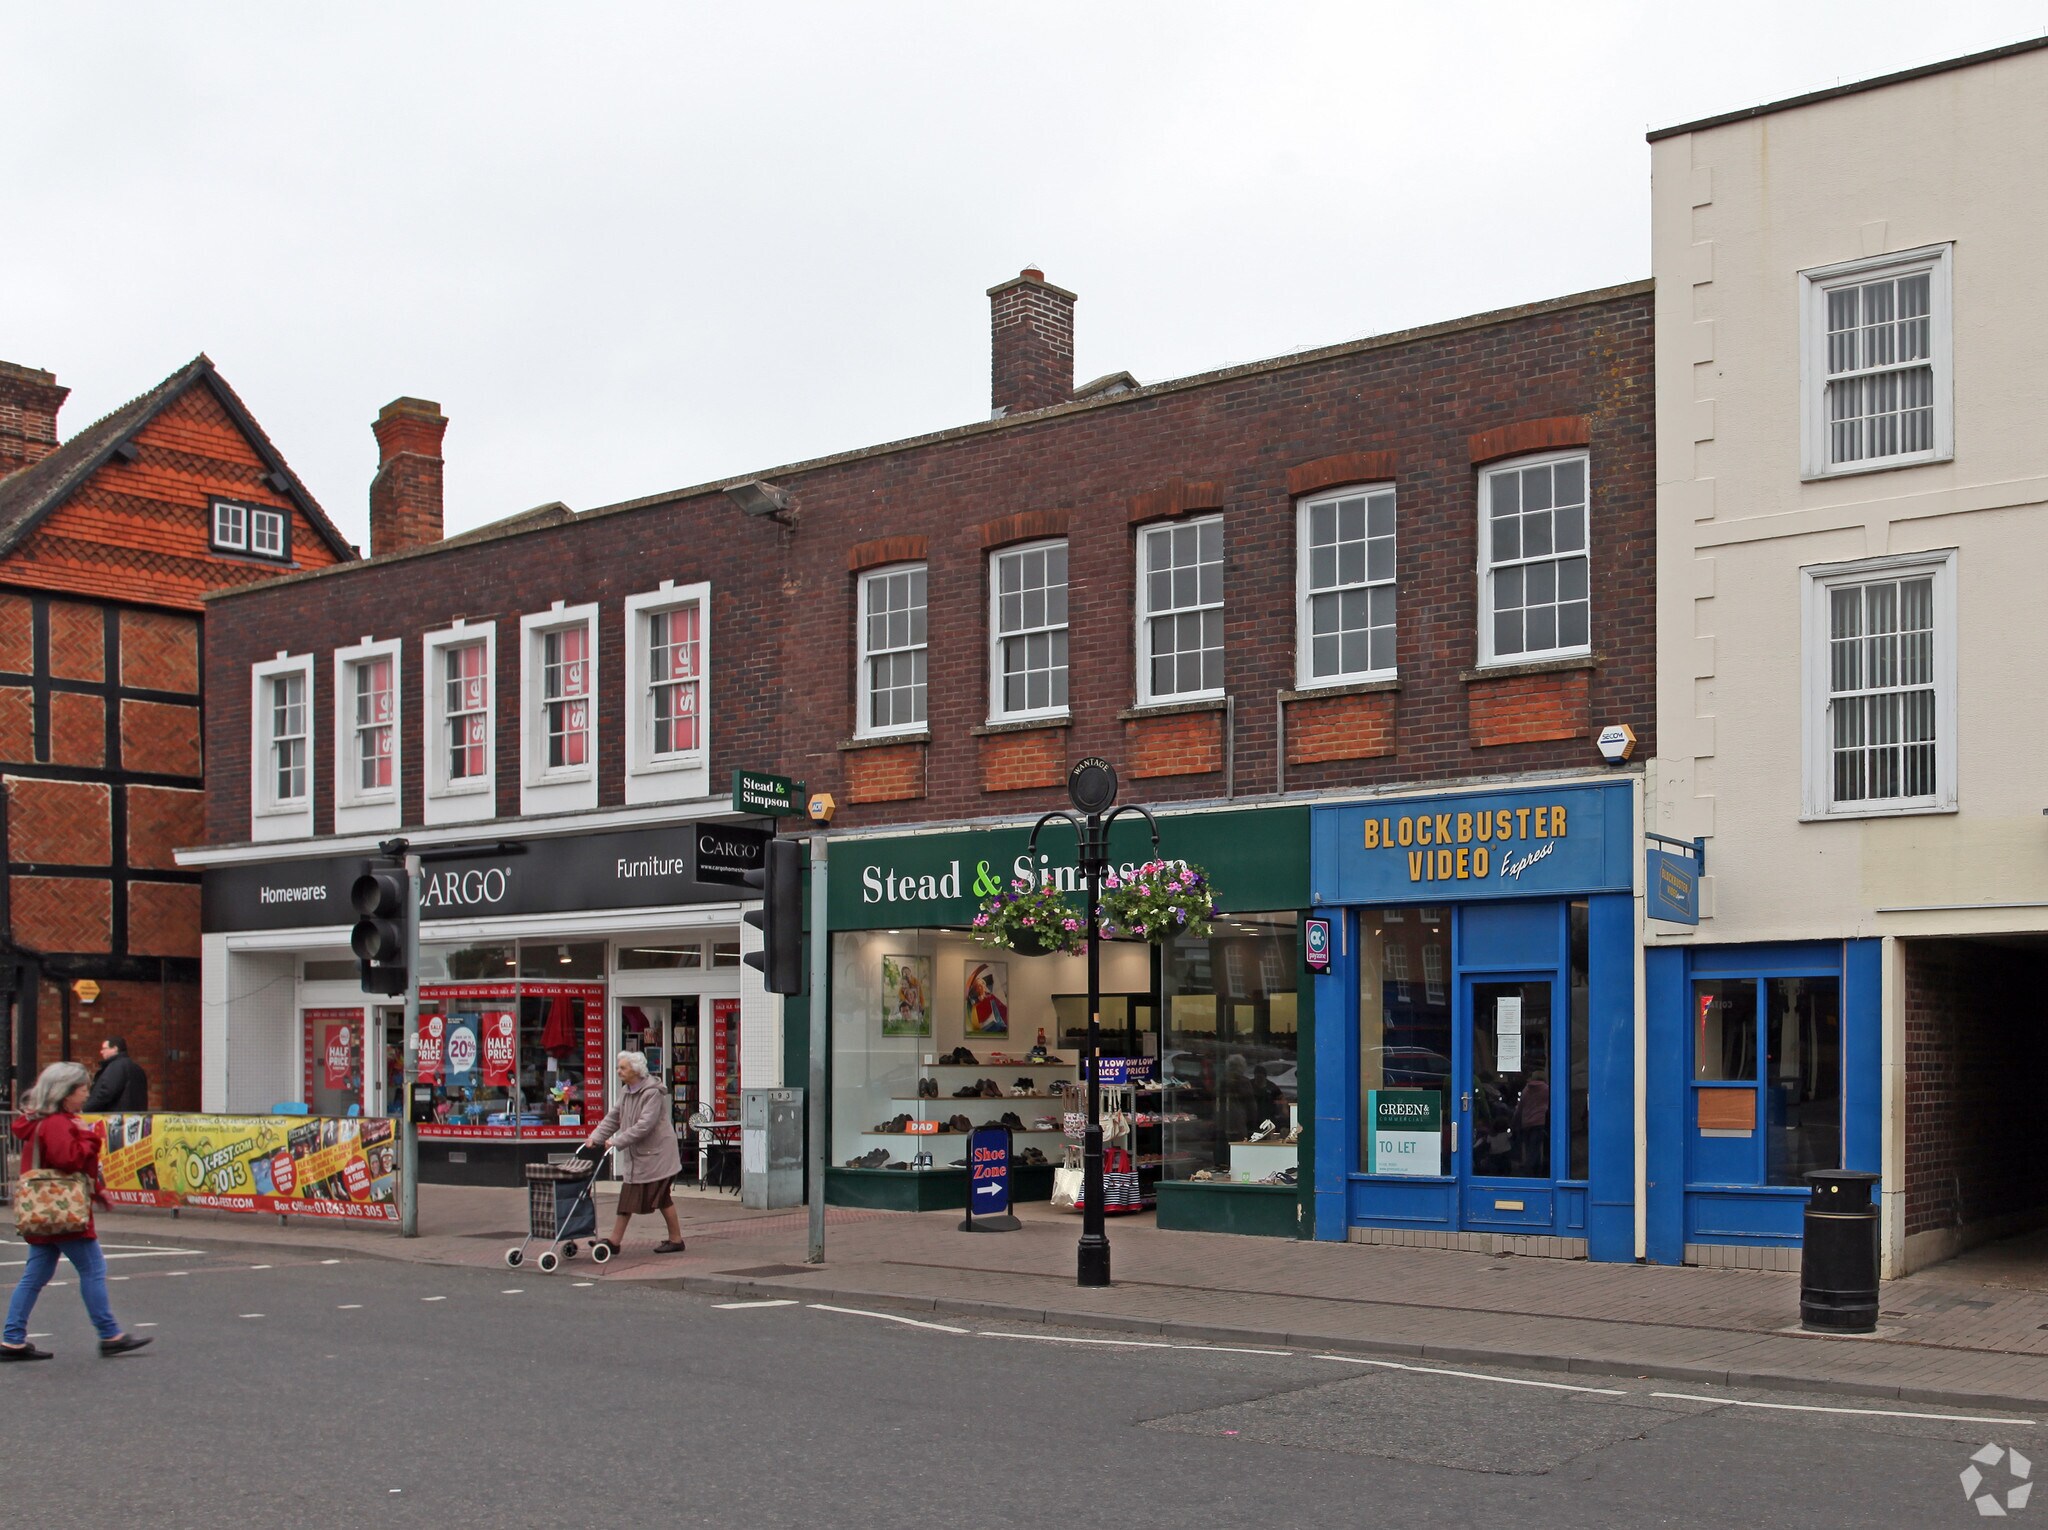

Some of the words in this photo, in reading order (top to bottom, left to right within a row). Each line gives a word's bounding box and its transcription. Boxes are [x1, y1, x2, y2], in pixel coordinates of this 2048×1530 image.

[1602, 732, 1623, 740] SECOM
[1073, 758, 1109, 775] WANTAGE
[743, 777, 774, 792] Stead
[775, 783, 785, 794] &
[743, 791, 790, 808] Simpson
[1363, 805, 1568, 850] BLOCKBUSTER
[700, 835, 757, 858] CARGO
[617, 856, 683, 878] Furniture
[1408, 846, 1489, 882] VIDEO
[1500, 840, 1555, 880] Express
[862, 860, 963, 904] Stead
[972, 860, 1002, 898] &
[260, 884, 327, 904] Homewares
[329, 1046, 349, 1056] HALF
[488, 1038, 512, 1048] HALF
[329, 1057, 349, 1066] PRICE
[488, 1049, 512, 1059] PRICE
[1138, 1058, 1153, 1066] LOW
[1098, 1068, 1120, 1076] RICES
[911, 1123, 933, 1131] DAD
[974, 1147, 1006, 1162] Shoe
[1379, 1141, 1392, 1152] TO
[1398, 1142, 1416, 1154] LET
[185, 1138, 253, 1189] OX-FEST.COM
[213, 1162, 247, 1196] 2013
[352, 1170, 366, 1182] FREE
[973, 1164, 1007, 1180] Zone
[120, 1191, 138, 1203] JULY
[138, 1192, 156, 1204] 2013
[274, 1200, 290, 1211] Box
[291, 1201, 314, 1213] Office:
[314, 1202, 345, 1215] 01865
[346, 1204, 363, 1216] 305
[365, 1206, 383, 1217] 305
